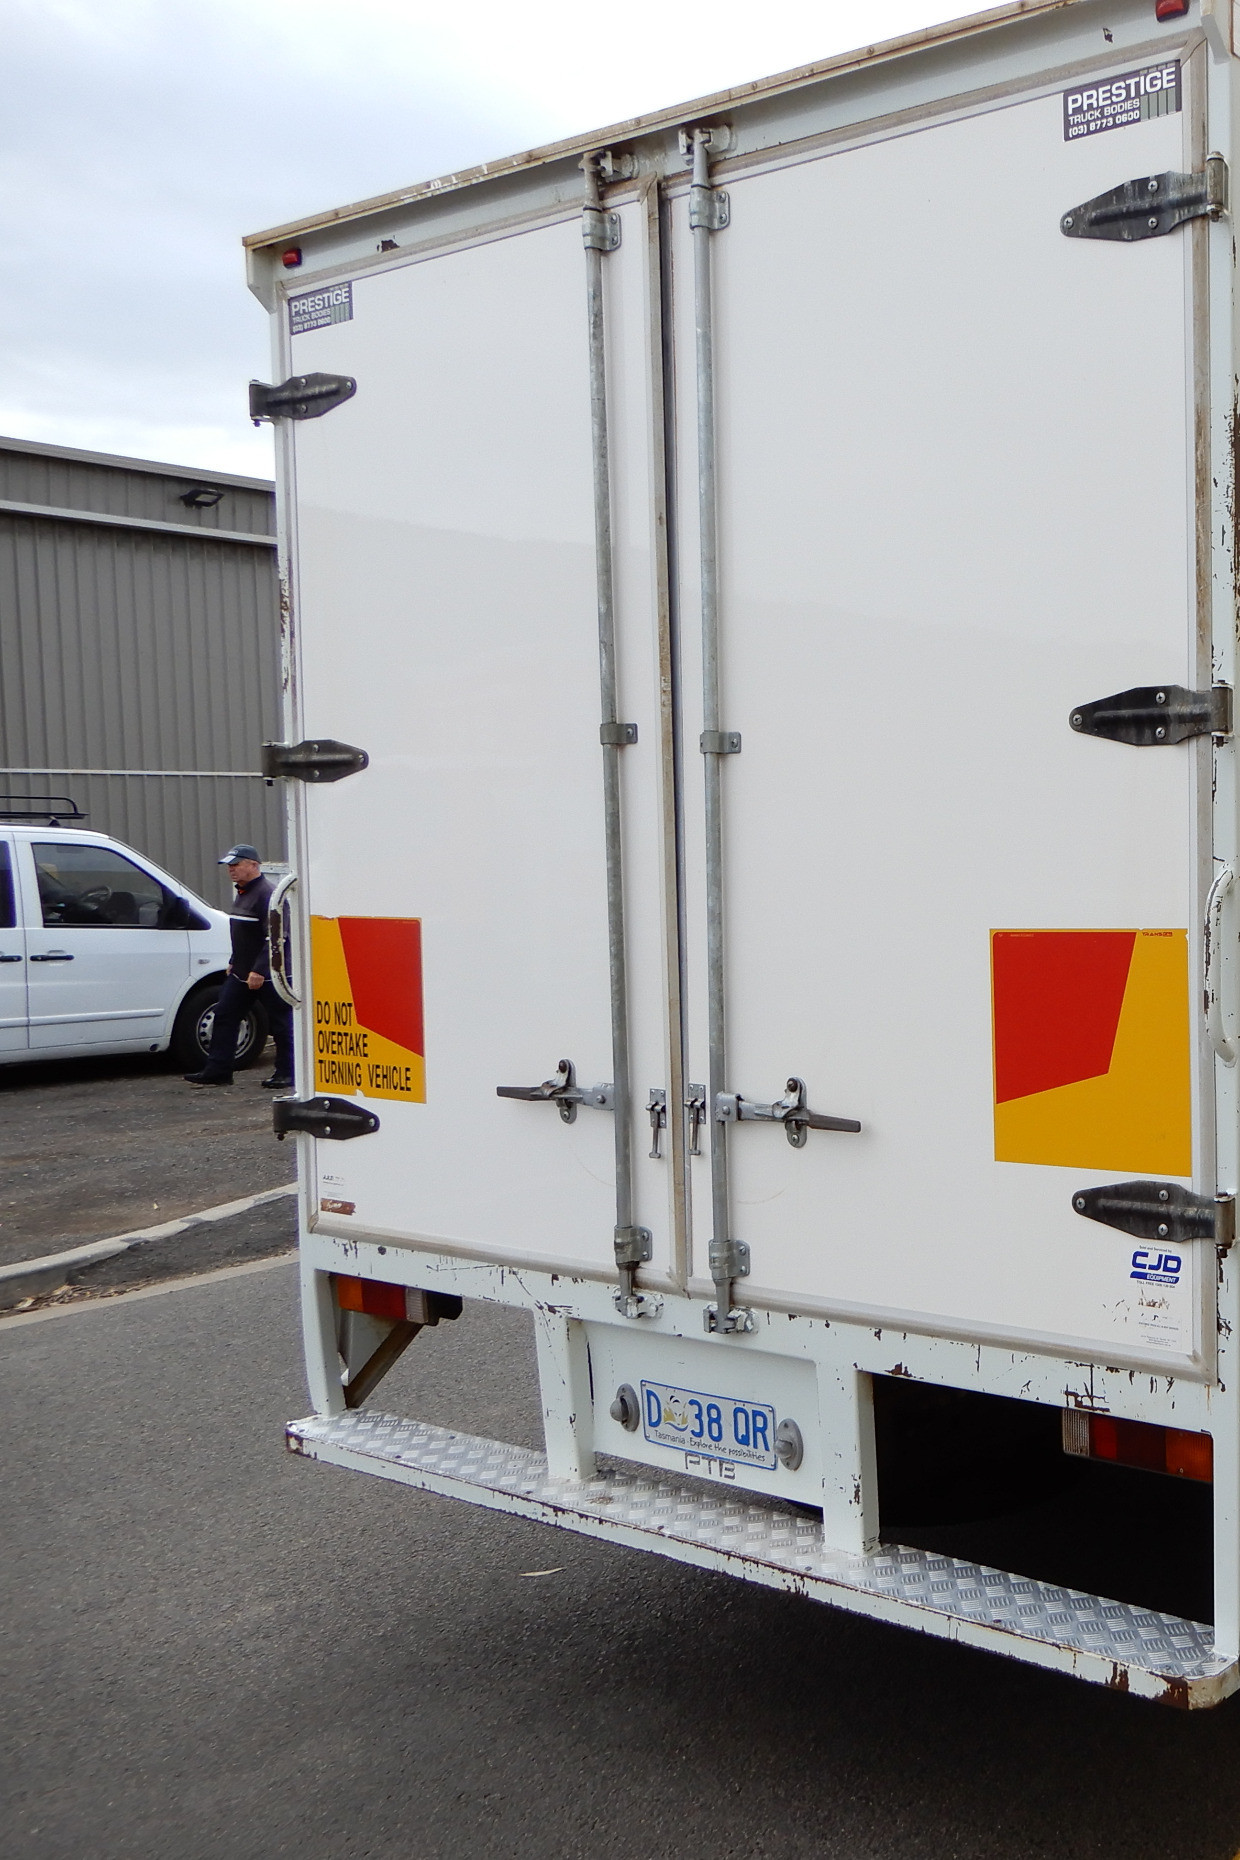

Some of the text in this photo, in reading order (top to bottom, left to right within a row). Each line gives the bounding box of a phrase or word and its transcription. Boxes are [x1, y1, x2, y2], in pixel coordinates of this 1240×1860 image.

[1067, 67, 1176, 115] PRESTIGE
[1068, 98, 1140, 126] TRUCK BODIES
[1068, 110, 1140, 138] (03) 8773 0600
[291, 288, 350, 316] PRESTIGE
[317, 1001, 353, 1026] DO NOT
[318, 1031, 368, 1057] OVERTAKE
[318, 1059, 412, 1091] TURNING VEHICLE
[1132, 1251, 1182, 1273] CJD
[1146, 1273, 1177, 1283] EQUIPMENT
[654, 1429, 686, 1445] Tasmania
[690, 1437, 713, 1451] Explore
